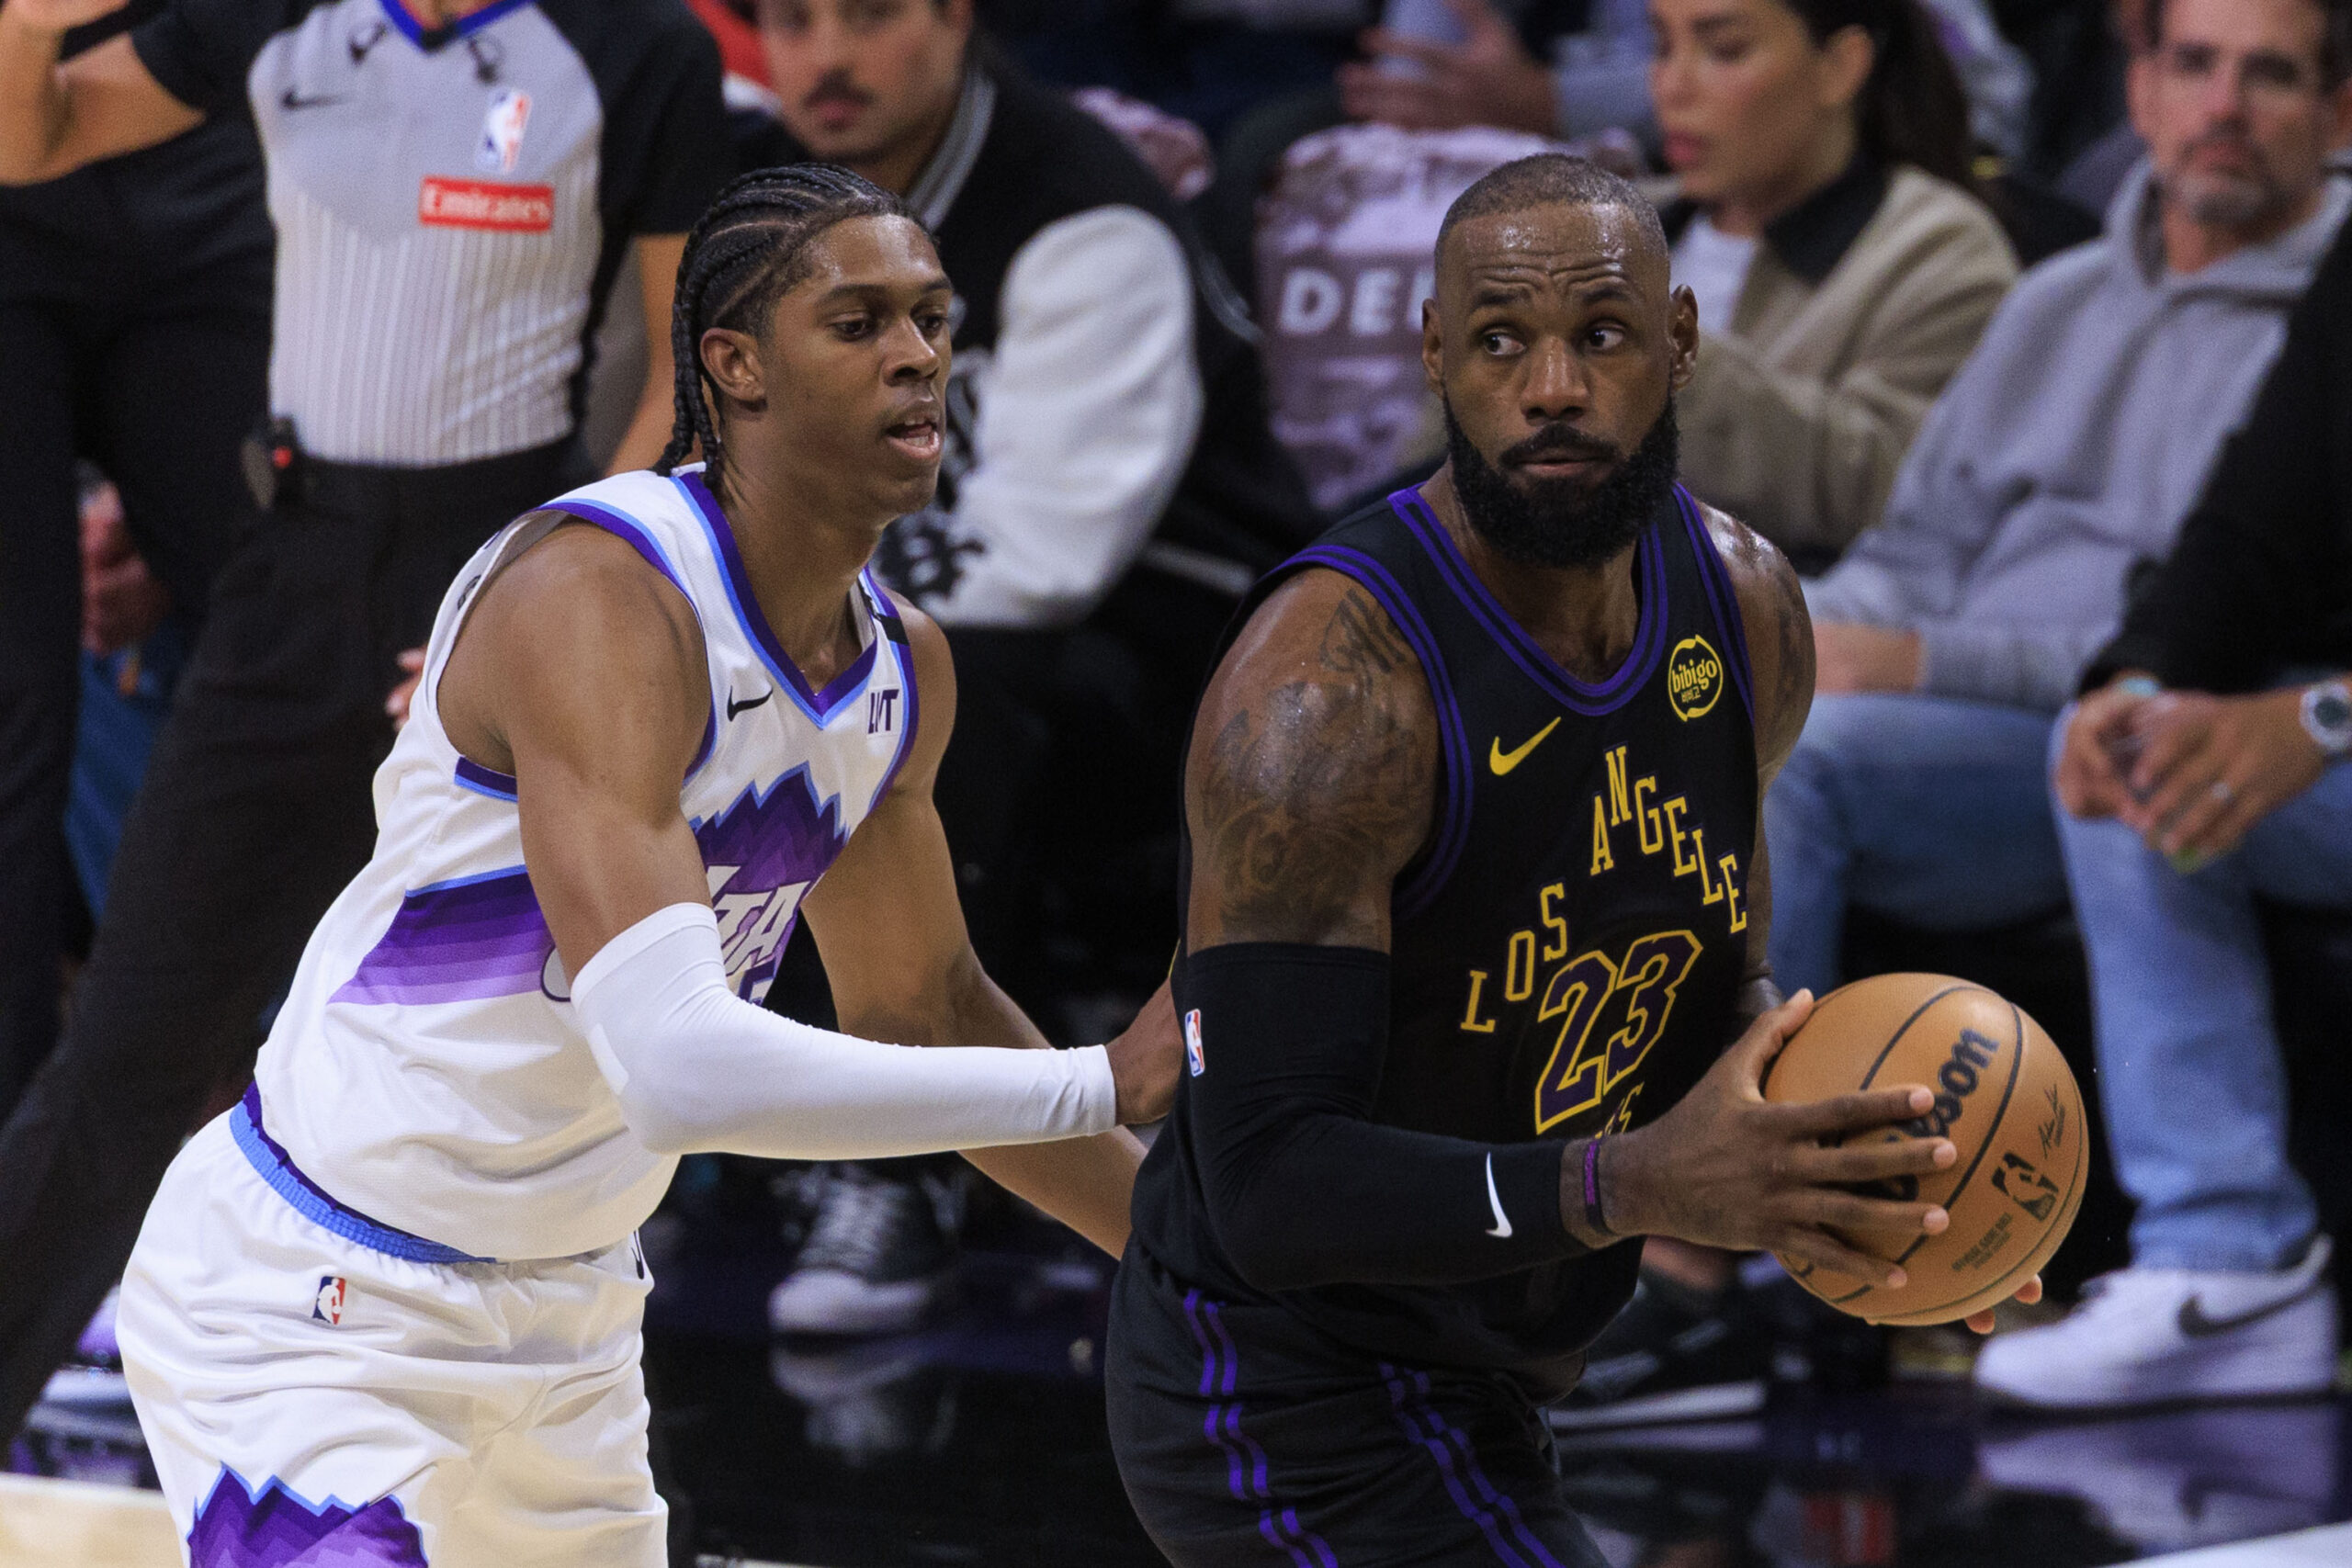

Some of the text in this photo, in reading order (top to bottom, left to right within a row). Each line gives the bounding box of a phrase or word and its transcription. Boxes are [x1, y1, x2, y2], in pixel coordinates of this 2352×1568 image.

[1672, 659, 1718, 694] bibigo
[1460, 882, 1568, 1033] LOS
[1534, 930, 1703, 1135] 23
